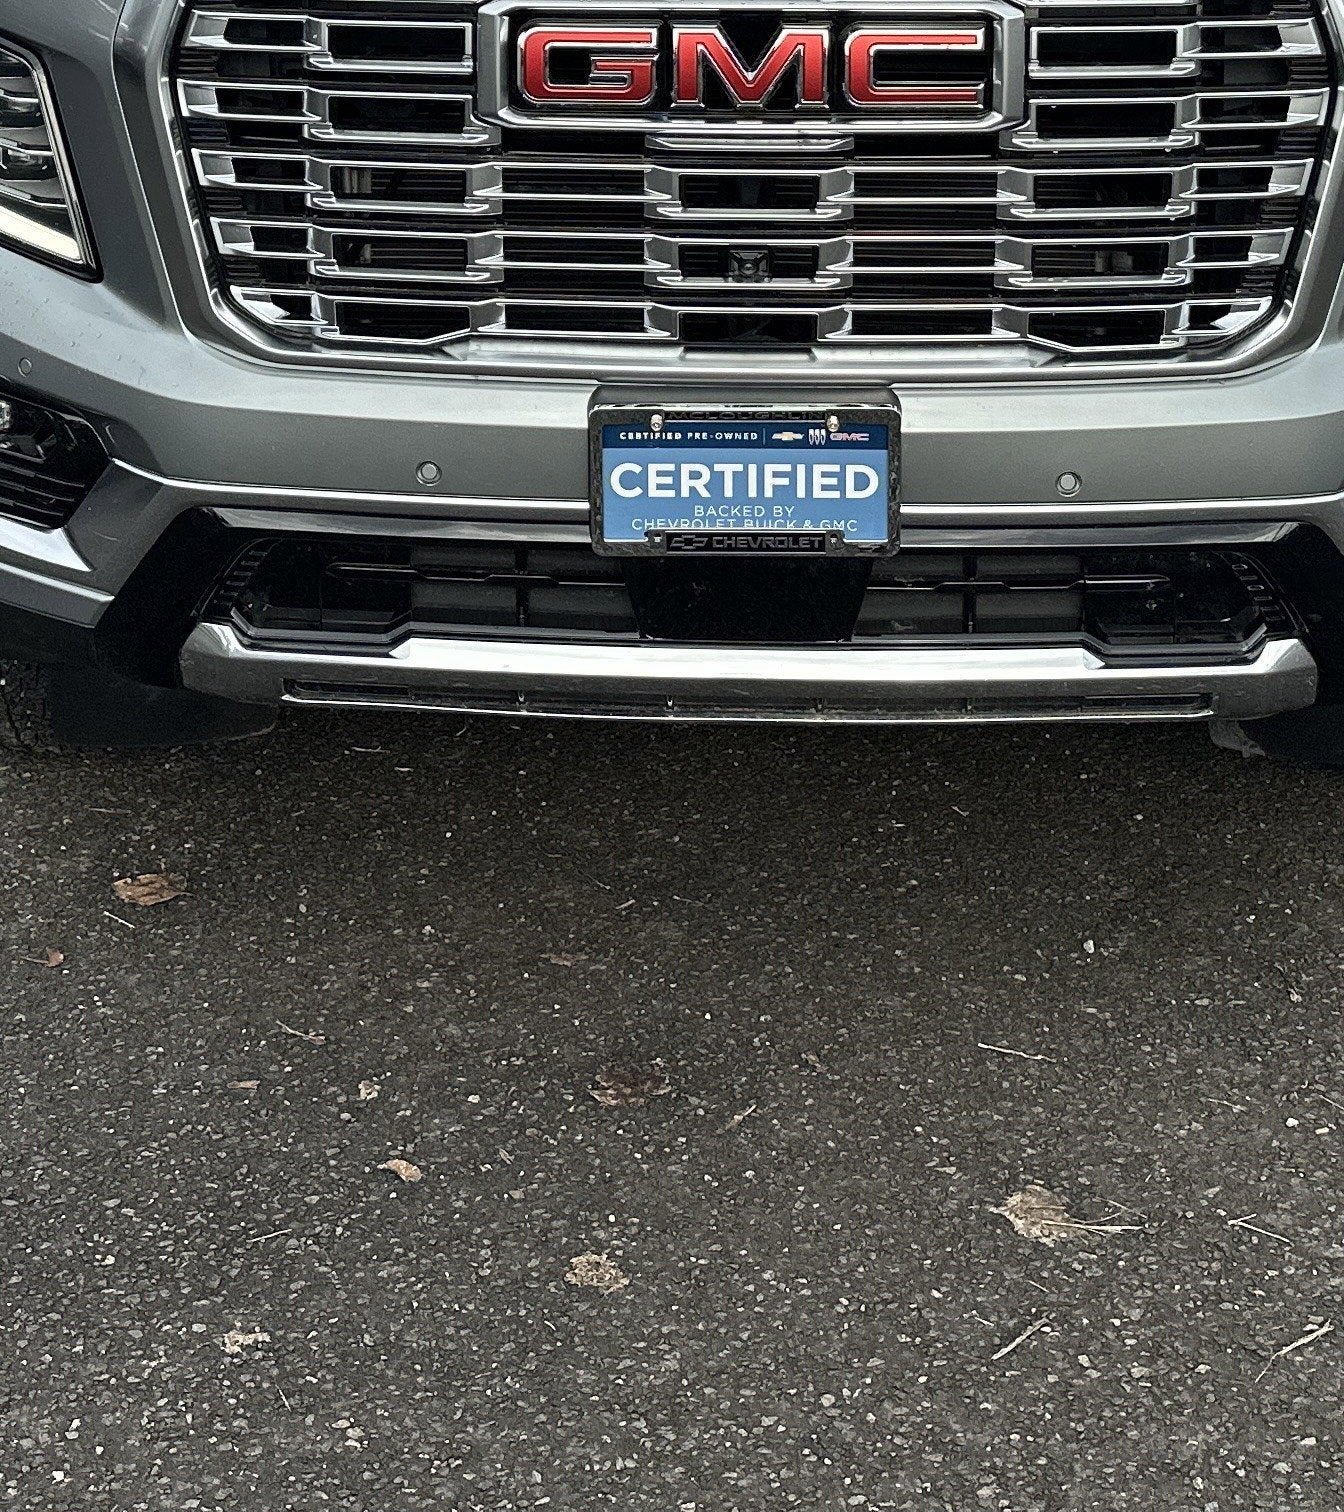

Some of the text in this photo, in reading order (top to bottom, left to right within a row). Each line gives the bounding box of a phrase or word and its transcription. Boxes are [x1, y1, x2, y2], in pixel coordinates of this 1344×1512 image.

[517, 23, 987, 109] GMC
[619, 431, 870, 441] CERTIFIED PRE-OWNED GMC
[609, 462, 880, 499] CERTIFIED
[693, 504, 795, 518] BACKED BY
[819, 520, 858, 532] GMC
[712, 536, 824, 549] CHEVROLET
